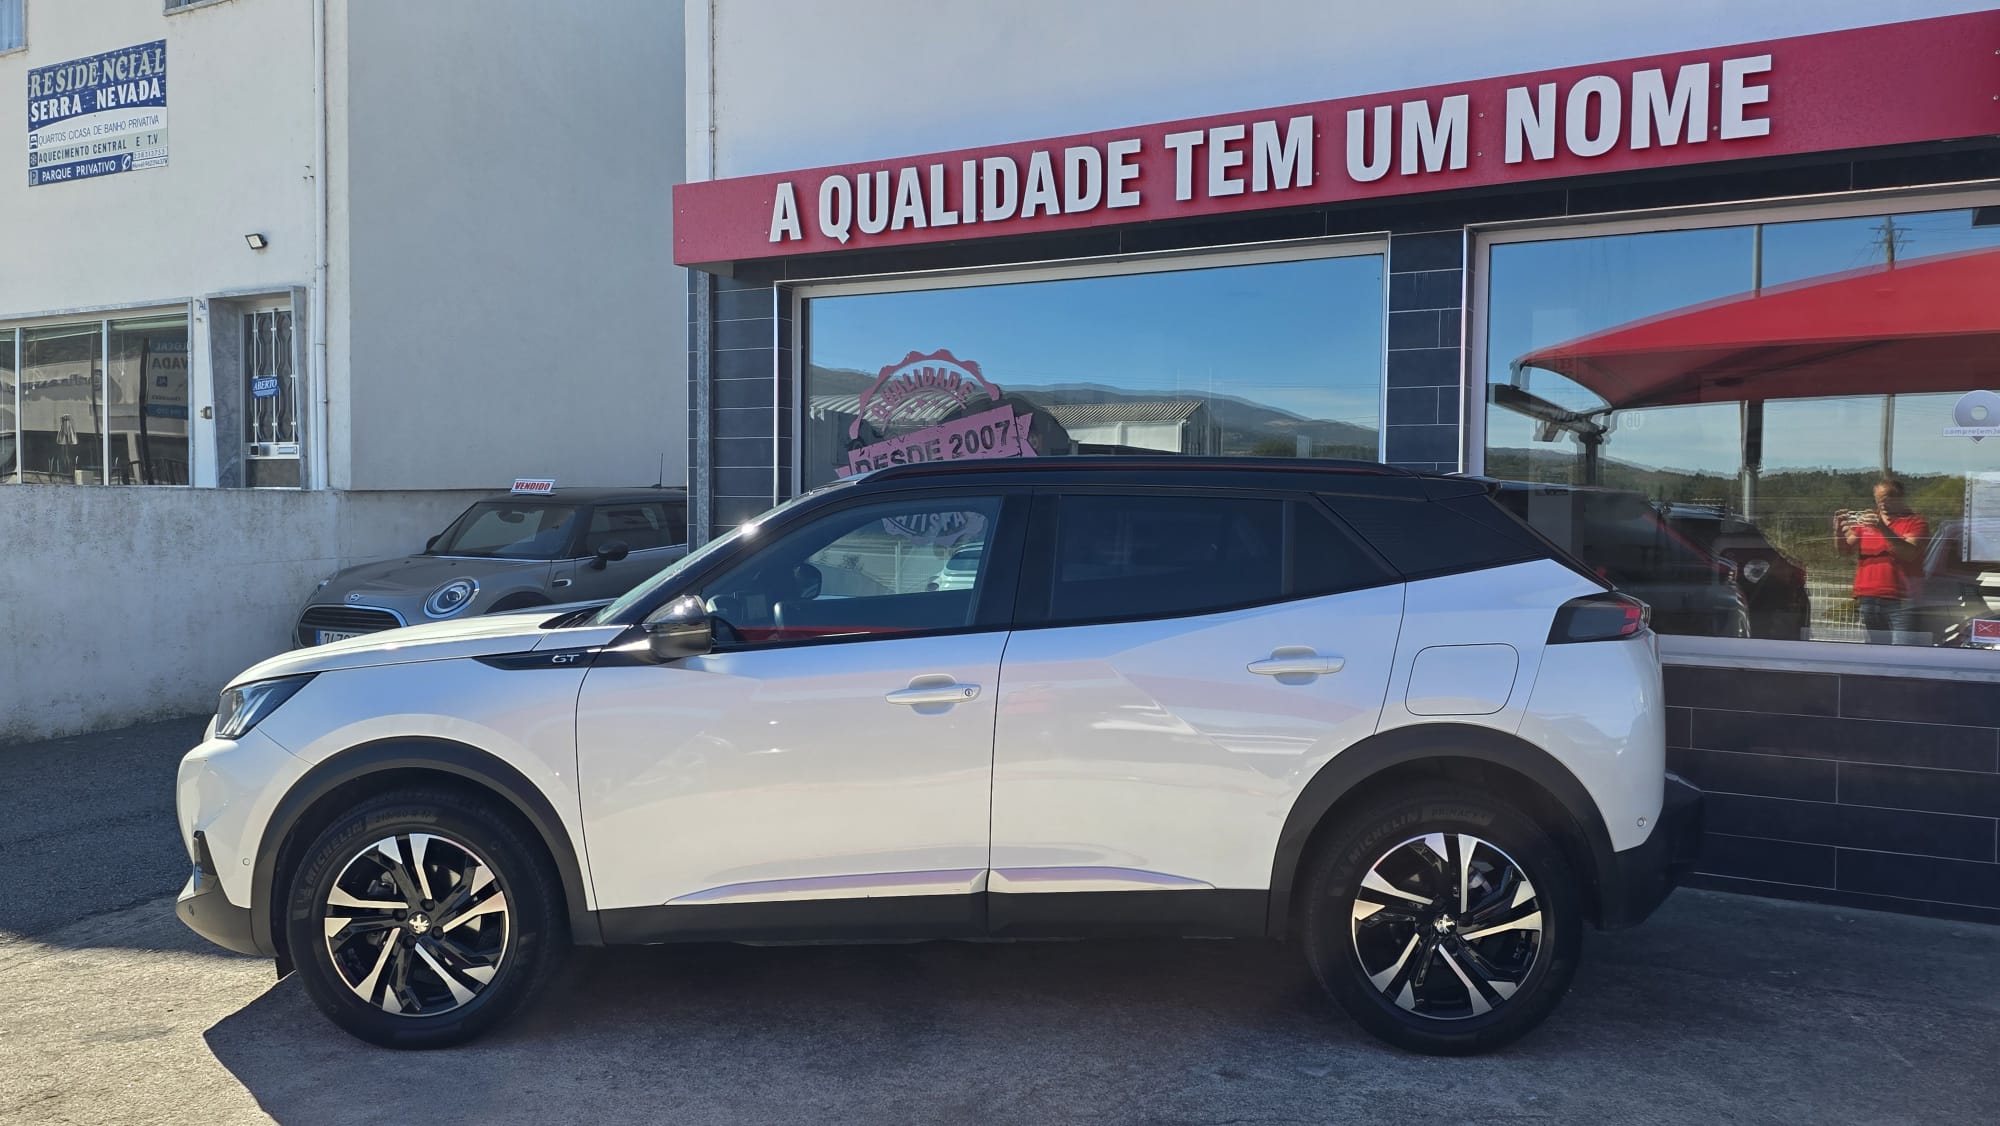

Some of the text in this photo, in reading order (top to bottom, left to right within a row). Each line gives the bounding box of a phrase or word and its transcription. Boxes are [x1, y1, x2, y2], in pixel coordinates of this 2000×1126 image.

[30, 49, 165, 98] RESIDENCIAL
[30, 77, 161, 122] SERRA NEVADA
[38, 131, 66, 146] QUARTOS
[93, 125, 103, 135] DE
[104, 121, 126, 134] BANHO
[128, 115, 160, 129] PRIVATIVA
[38, 145, 89, 163] AQUECIMENTO
[93, 139, 127, 154] CENTRAL
[136, 136, 140, 147] E
[769, 54, 1772, 244] A QUALIDADE TEM UM NOME
[42, 167, 72, 182] PARQUE
[76, 160, 116, 177] PRIVATIVO
[254, 379, 278, 391] ABERTO
[871, 366, 974, 419] QUALIDADE
[855, 419, 1011, 475] DESDE 2007
[515, 482, 551, 491] VENDIDO
[551, 653, 580, 664] GT
